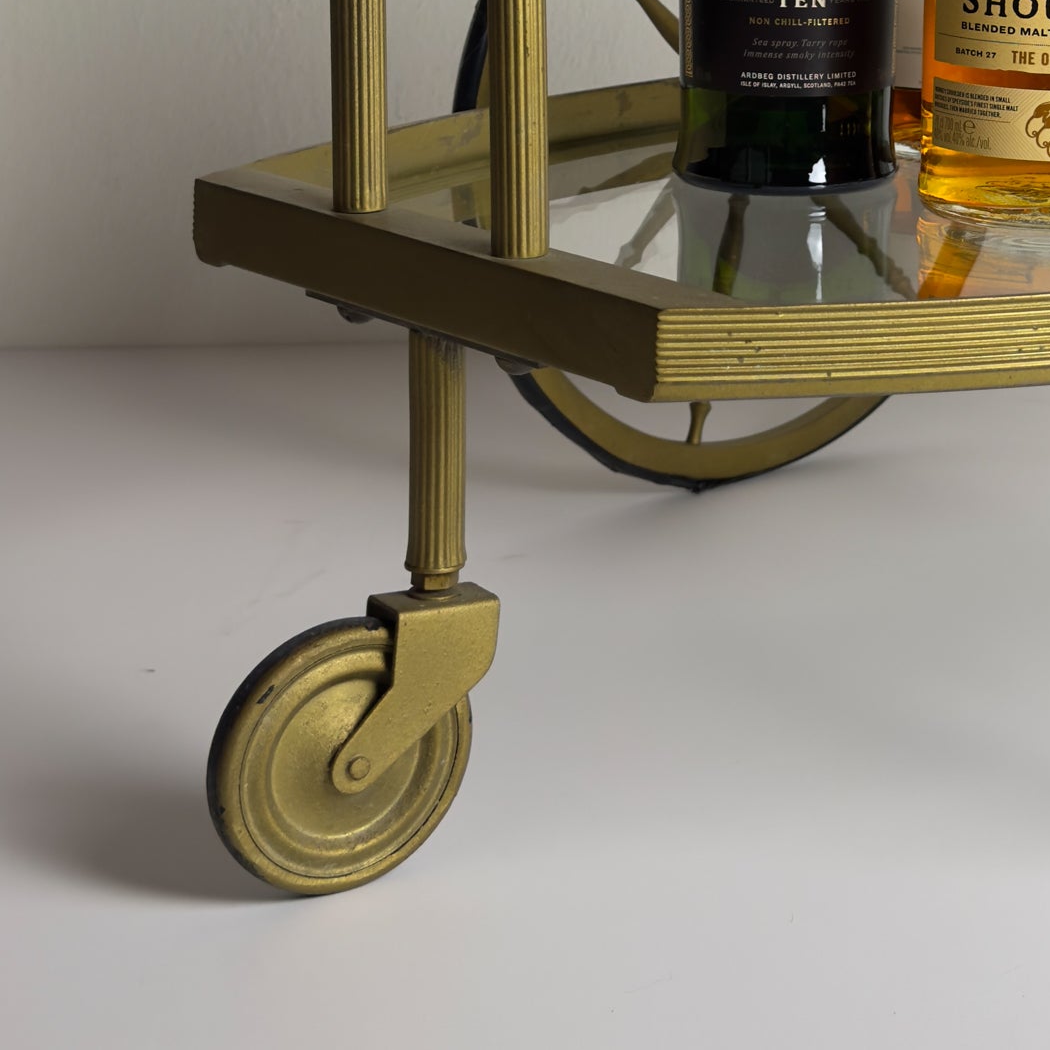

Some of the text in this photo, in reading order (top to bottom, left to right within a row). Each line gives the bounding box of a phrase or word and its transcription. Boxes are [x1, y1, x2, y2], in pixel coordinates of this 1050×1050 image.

[749, 17, 850, 27] NON CHILL-FILTERED
[961, 21, 1016, 35] BLENDED
[752, 37, 768, 47] Sea
[801, 38, 827, 48] Tarry
[786, 50, 816, 61] smoky
[955, 47, 983, 57] BATCH
[1011, 50, 1036, 65] THE
[741, 71, 857, 81] ARDBEG DISTILLERY LIMITED
[761, 81, 778, 89] ISLAY,
[995, 95, 1011, 104] SMALL
[989, 102, 1005, 111] SINGLE
[1005, 104, 1019, 112] MALT
